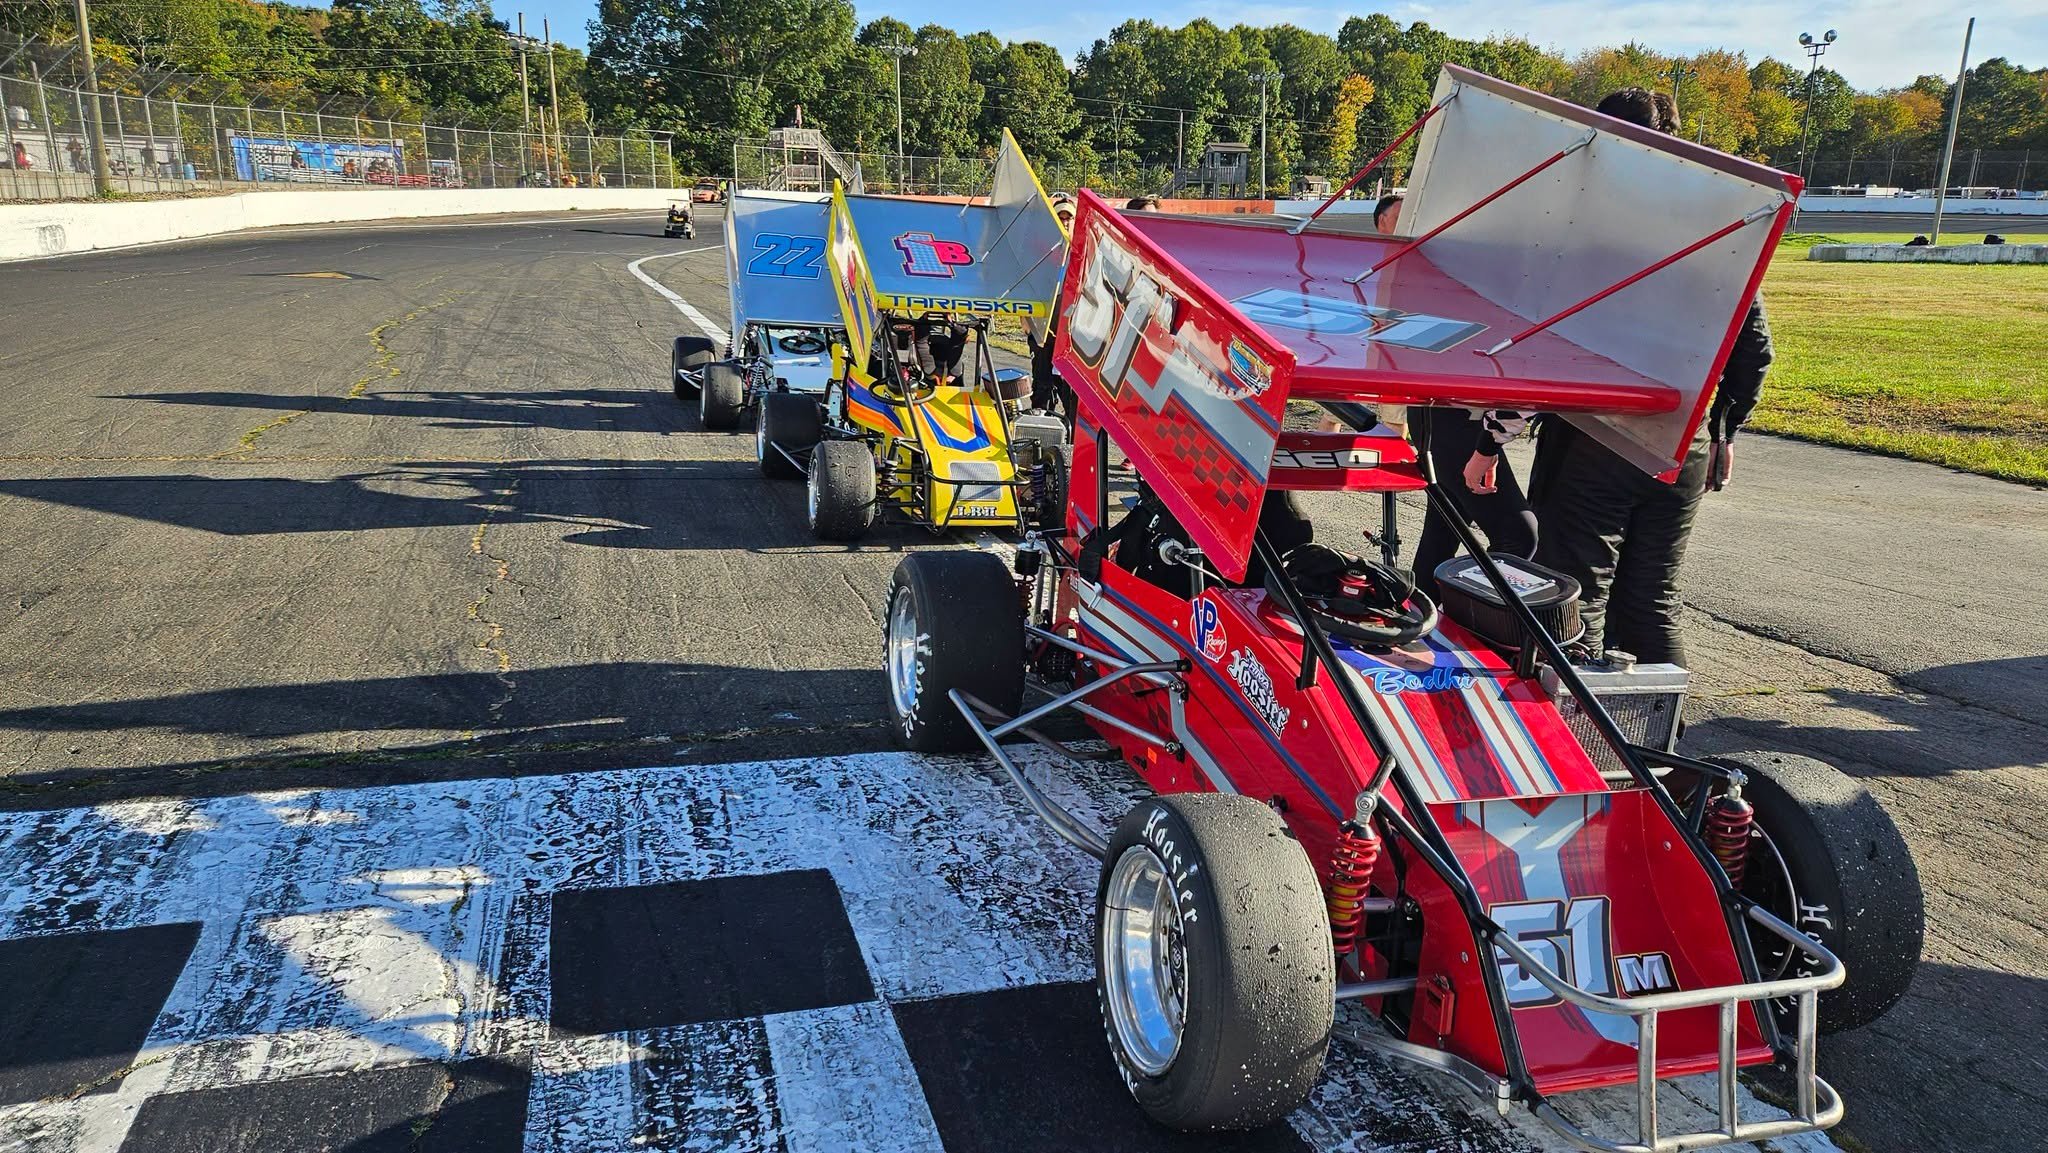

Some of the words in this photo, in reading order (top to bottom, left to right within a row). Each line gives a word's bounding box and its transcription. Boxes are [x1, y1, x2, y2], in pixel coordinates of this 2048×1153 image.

[746, 232, 828, 280] 22
[886, 295, 1033, 314] TARASKA
[1068, 228, 1163, 402] 51
[1228, 287, 1492, 354] 51
[1192, 598, 1218, 653] VP
[1228, 650, 1287, 727] Hoosier
[1243, 687, 1268, 717] RACING
[1361, 666, 1477, 695] Bodhi
[1143, 808, 1198, 922] Hoosier
[1488, 895, 1619, 1009] 51
